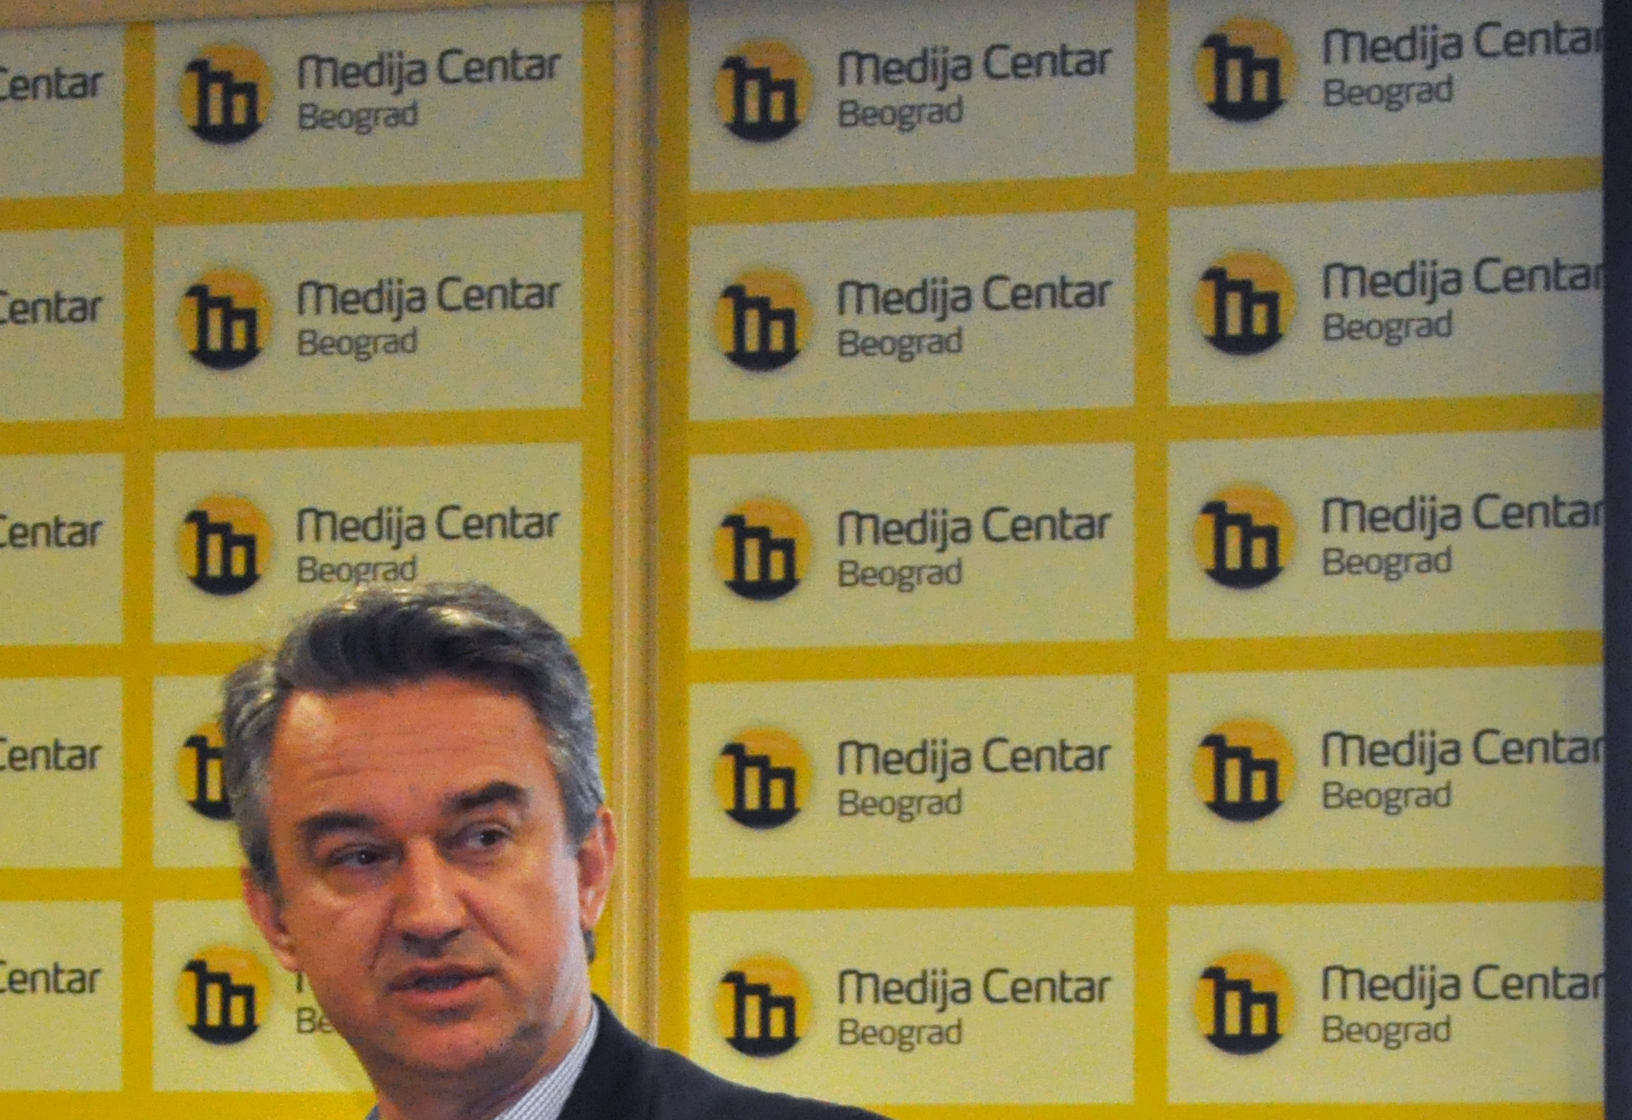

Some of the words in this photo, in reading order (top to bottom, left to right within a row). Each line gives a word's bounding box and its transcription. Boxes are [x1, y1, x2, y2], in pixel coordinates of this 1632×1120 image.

[838, 46, 973, 93] Medija
[982, 43, 1113, 81] Centar
[1322, 23, 1462, 71] Medija
[297, 50, 427, 97] Medija
[435, 47, 562, 85] Centar
[1322, 74, 1452, 112] Beograd
[297, 102, 417, 135] Beograd
[838, 96, 963, 133] Beograd
[297, 278, 427, 323] Medija
[435, 275, 562, 313] Centar
[838, 277, 973, 323] Medija
[982, 274, 1113, 312] Centar
[1322, 259, 1462, 306] Medija
[297, 328, 417, 362] Beograd
[838, 327, 963, 363] Beograd
[1322, 309, 1452, 347] Beograd
[297, 506, 427, 551] Medija
[435, 504, 562, 541] Centar
[838, 508, 973, 554] Medija
[982, 505, 1113, 544] Centar
[1322, 495, 1462, 542] Medija
[297, 555, 417, 589] Beograd
[838, 559, 963, 593] Beograd
[1322, 547, 1452, 582] Beograd
[838, 738, 973, 784] Medija
[982, 736, 1113, 774] Centar
[1322, 729, 1462, 776] Medija
[838, 789, 963, 823] Beograd
[1322, 781, 1452, 816] Beograd
[838, 968, 973, 1014] Medija
[982, 967, 1113, 1005] Centar
[1322, 964, 1462, 1011] Medija
[838, 1018, 963, 1052] Beograd
[1322, 1015, 1452, 1050] Beograd
